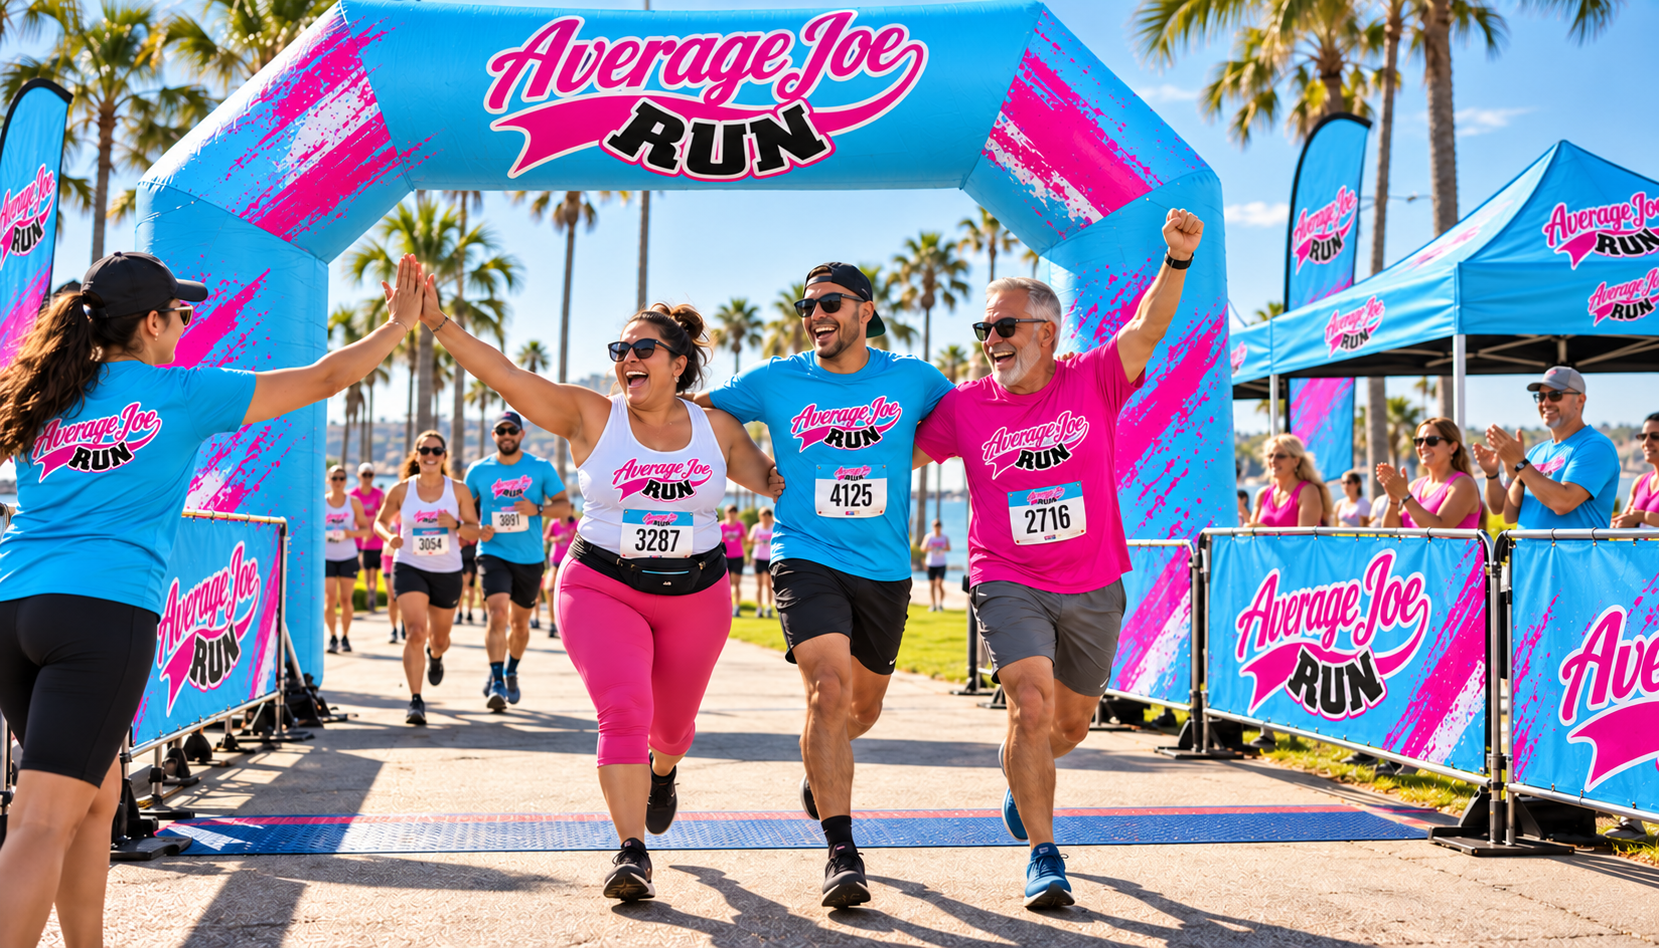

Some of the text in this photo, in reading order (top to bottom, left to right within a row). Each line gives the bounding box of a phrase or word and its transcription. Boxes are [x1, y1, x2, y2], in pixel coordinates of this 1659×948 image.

[486, 11, 911, 111] Average Joe
[601, 100, 829, 177] RUN
[1333, 185, 1355, 228] Joe
[11, 216, 44, 253] RUN
[1543, 202, 1632, 247] Average
[1595, 227, 1659, 255] RUN
[1309, 231, 1343, 262] RUN
[1588, 278, 1644, 314] Average
[1610, 298, 1654, 320] RUN
[1341, 328, 1370, 350] RUN
[32, 402, 157, 459] Average Joe
[791, 396, 899, 433] Average Joe
[823, 425, 881, 448] RUN
[982, 410, 1085, 460] Average Joe
[68, 441, 133, 471] RUN
[612, 458, 711, 485] Average Joe
[1014, 442, 1071, 470] RUN
[641, 479, 695, 500] RUN
[830, 483, 873, 507] 4125
[1024, 504, 1071, 534] 2716
[419, 537, 442, 551] 3054
[635, 528, 681, 552] 3287
[157, 541, 258, 668] Average Joe
[1236, 550, 1425, 661] Average Joe
[189, 623, 240, 686] RUN
[1287, 644, 1385, 716] RUN
